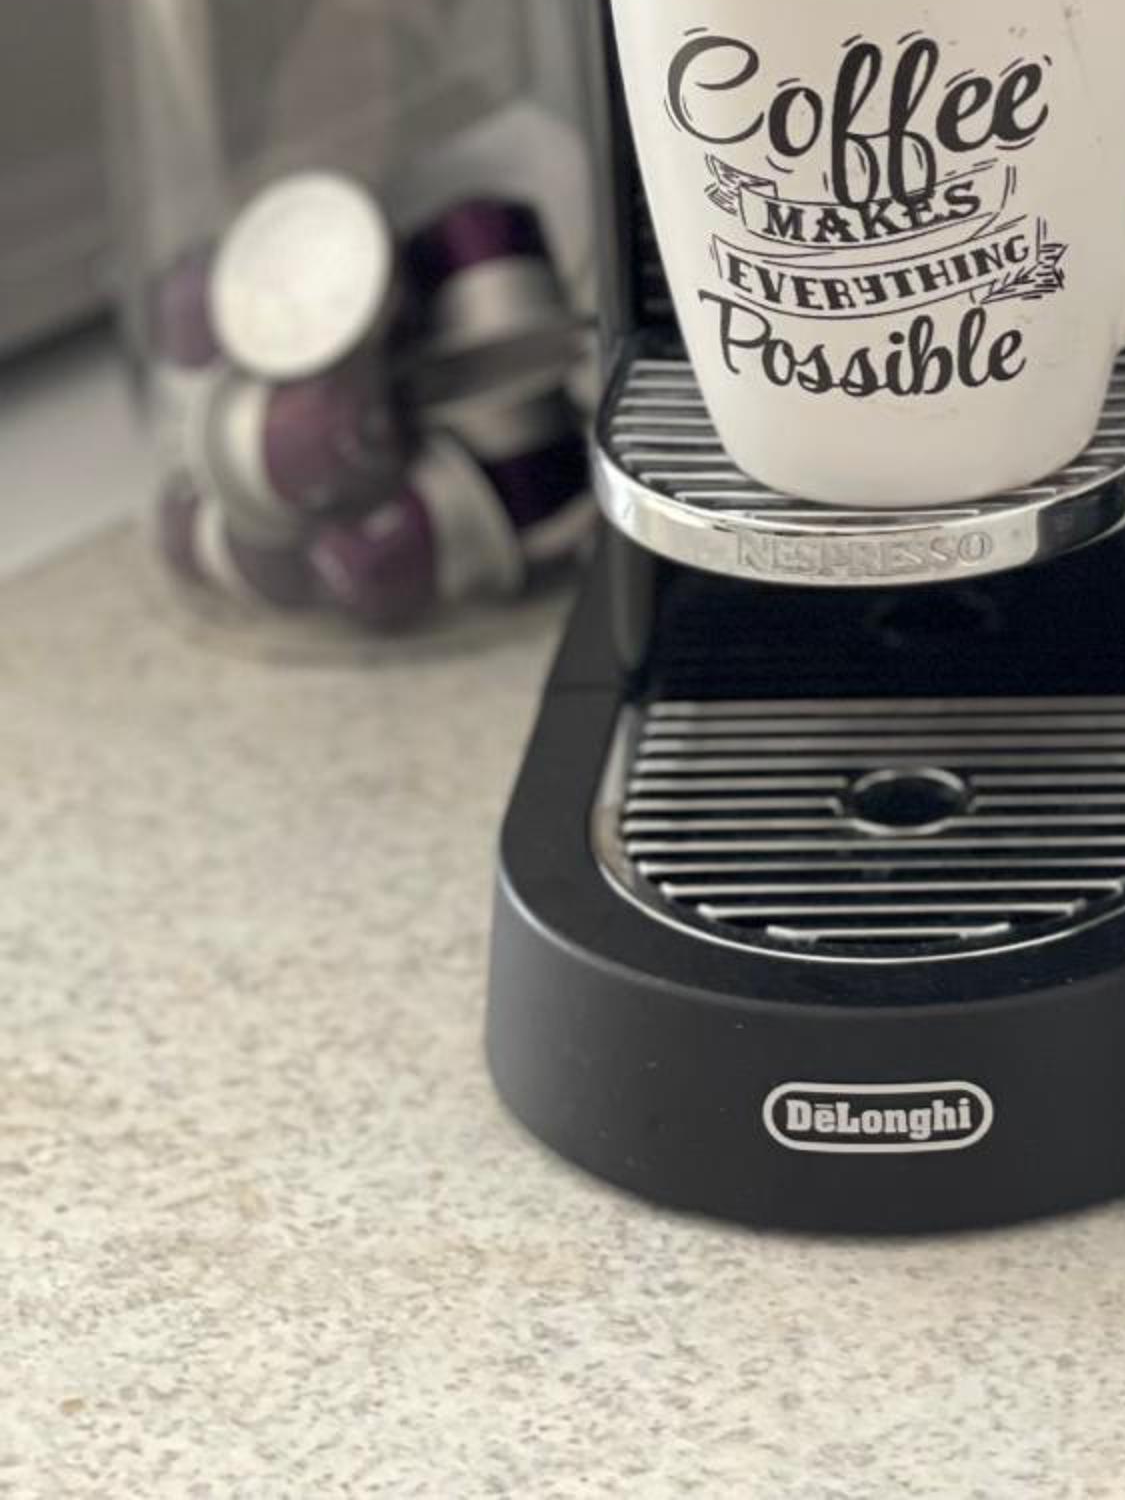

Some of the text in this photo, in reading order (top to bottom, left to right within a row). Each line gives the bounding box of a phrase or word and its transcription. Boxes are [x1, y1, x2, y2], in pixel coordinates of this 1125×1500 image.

[667, 35, 1050, 208] Coffee
[762, 180, 982, 243] MAKES
[723, 233, 1031, 311] EVERYTHING
[697, 288, 1027, 397] Possible
[736, 527, 994, 576] NESPRESSO
